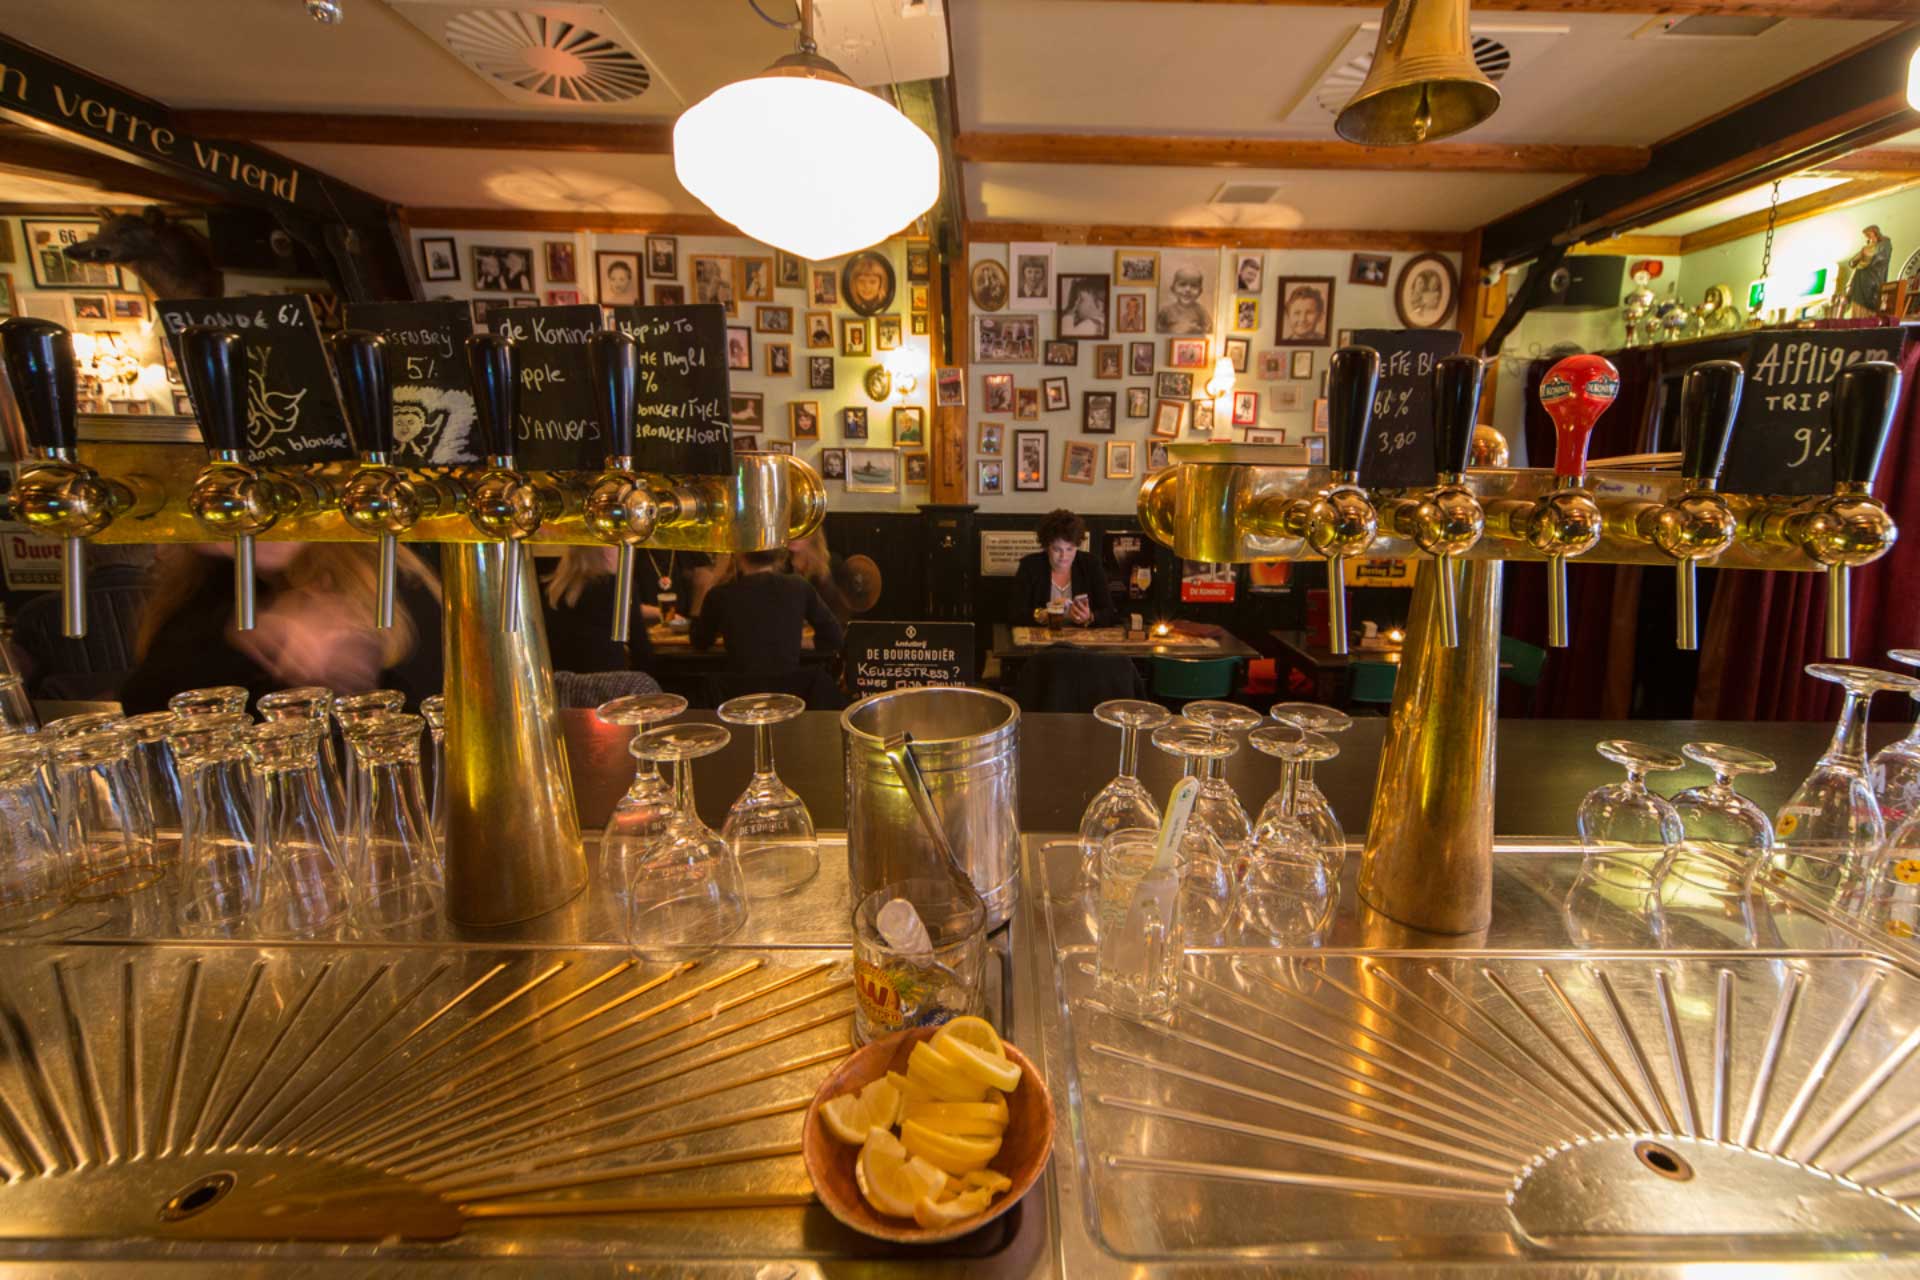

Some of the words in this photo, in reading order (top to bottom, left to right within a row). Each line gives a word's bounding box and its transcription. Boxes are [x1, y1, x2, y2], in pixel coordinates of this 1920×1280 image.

[54, 85, 175, 154] verre
[192, 141, 299, 203] vriend
[59, 229, 77, 244] 66
[278, 305, 304, 327] 6%
[500, 318, 528, 341] de
[407, 355, 438, 380] 5%
[640, 352, 657, 365] HE
[1765, 391, 1831, 411] TRIP
[1379, 431, 1416, 454] 3,80
[13, 535, 62, 559] Duve
[866, 648, 880, 660] DE
